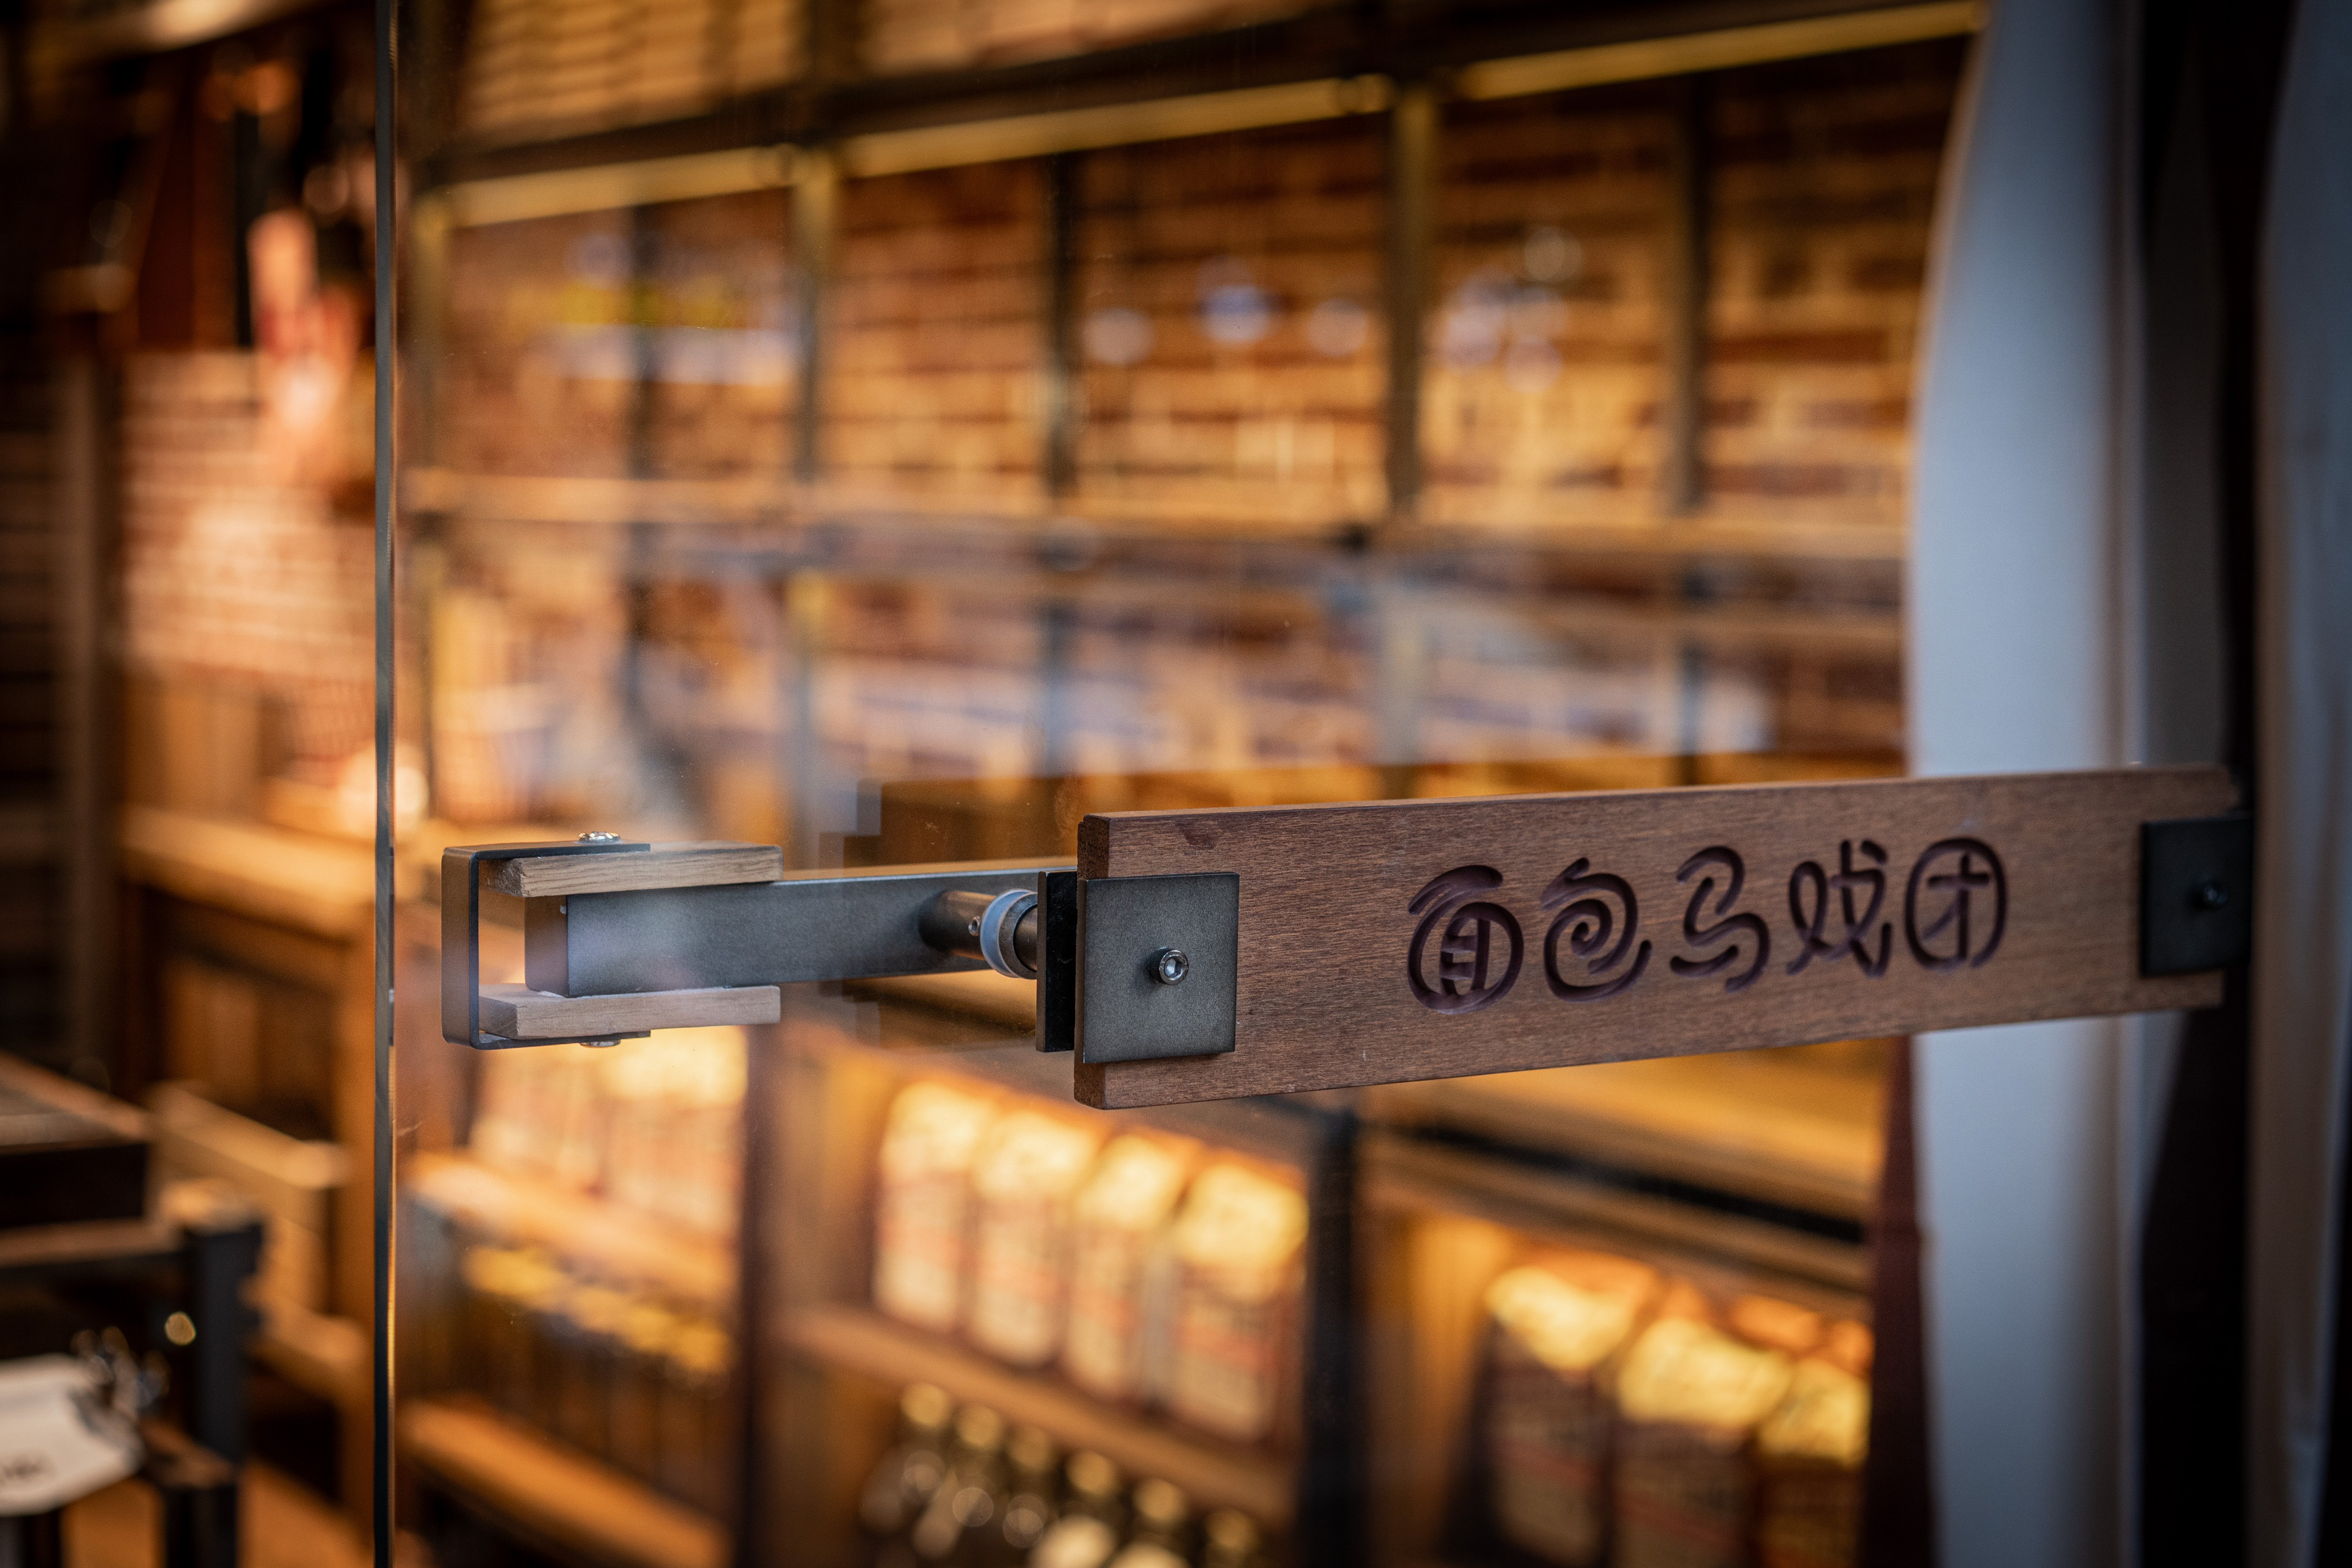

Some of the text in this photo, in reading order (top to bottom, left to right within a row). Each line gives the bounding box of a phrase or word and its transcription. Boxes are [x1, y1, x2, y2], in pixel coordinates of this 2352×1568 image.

[1408, 838, 2007, 1014] 面包马戏团
